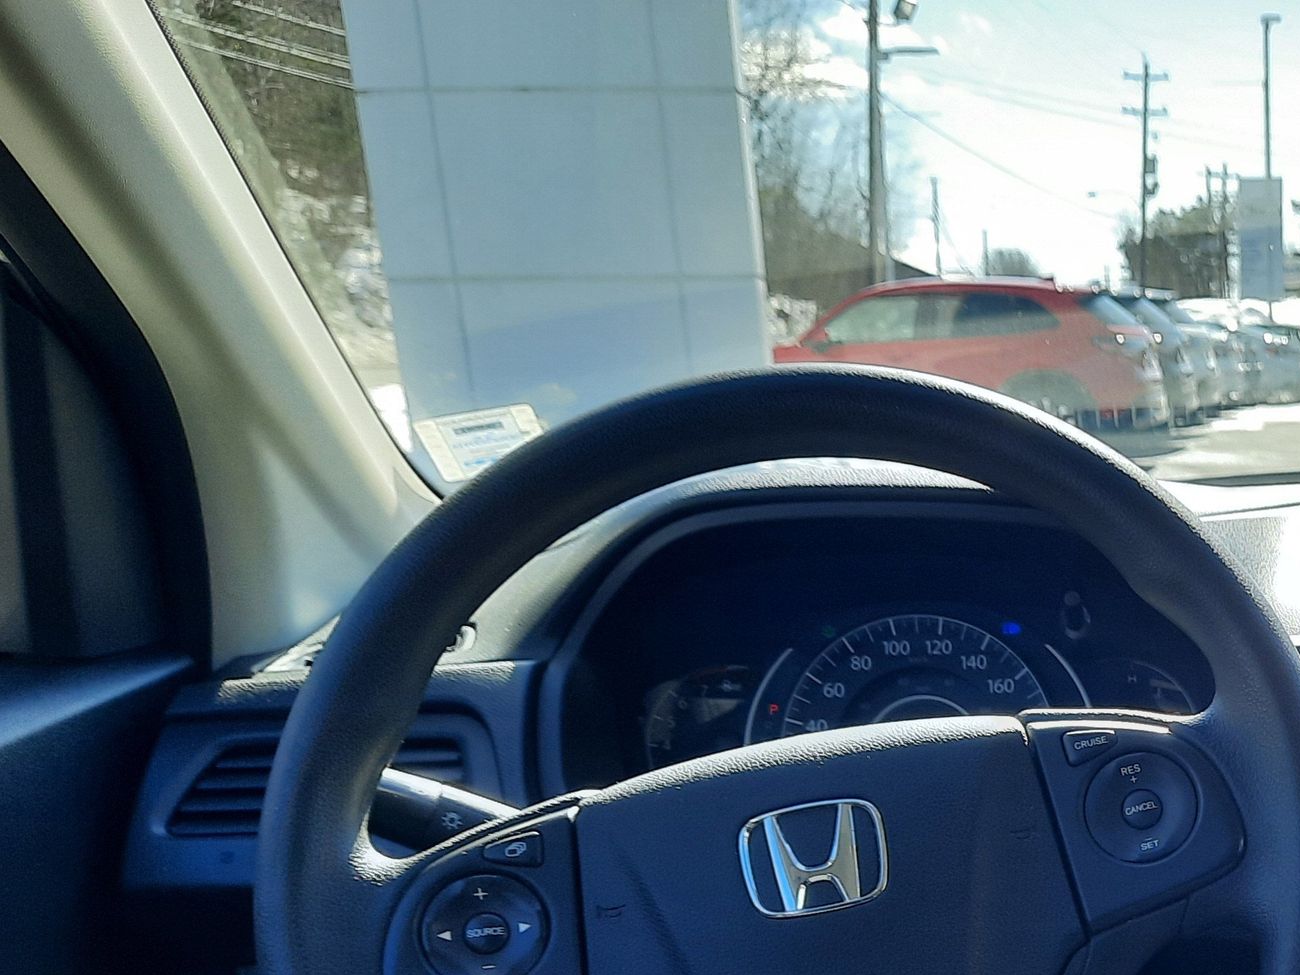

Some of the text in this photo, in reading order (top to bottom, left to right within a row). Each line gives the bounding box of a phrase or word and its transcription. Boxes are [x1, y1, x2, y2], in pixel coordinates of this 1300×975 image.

[883, 641, 911, 656] 100
[925, 640, 953, 655] 120
[850, 655, 872, 671] 80
[960, 654, 988, 670] 140
[823, 682, 845, 698] 60
[987, 678, 1015, 694] 160
[769, 704, 779, 715] P
[804, 719, 828, 732] 40
[1073, 735, 1109, 750] CRUISE
[1120, 763, 1142, 776] RES
[1124, 801, 1159, 816] CANCEL
[1140, 839, 1159, 851] SET
[465, 925, 506, 938] SOURCE
